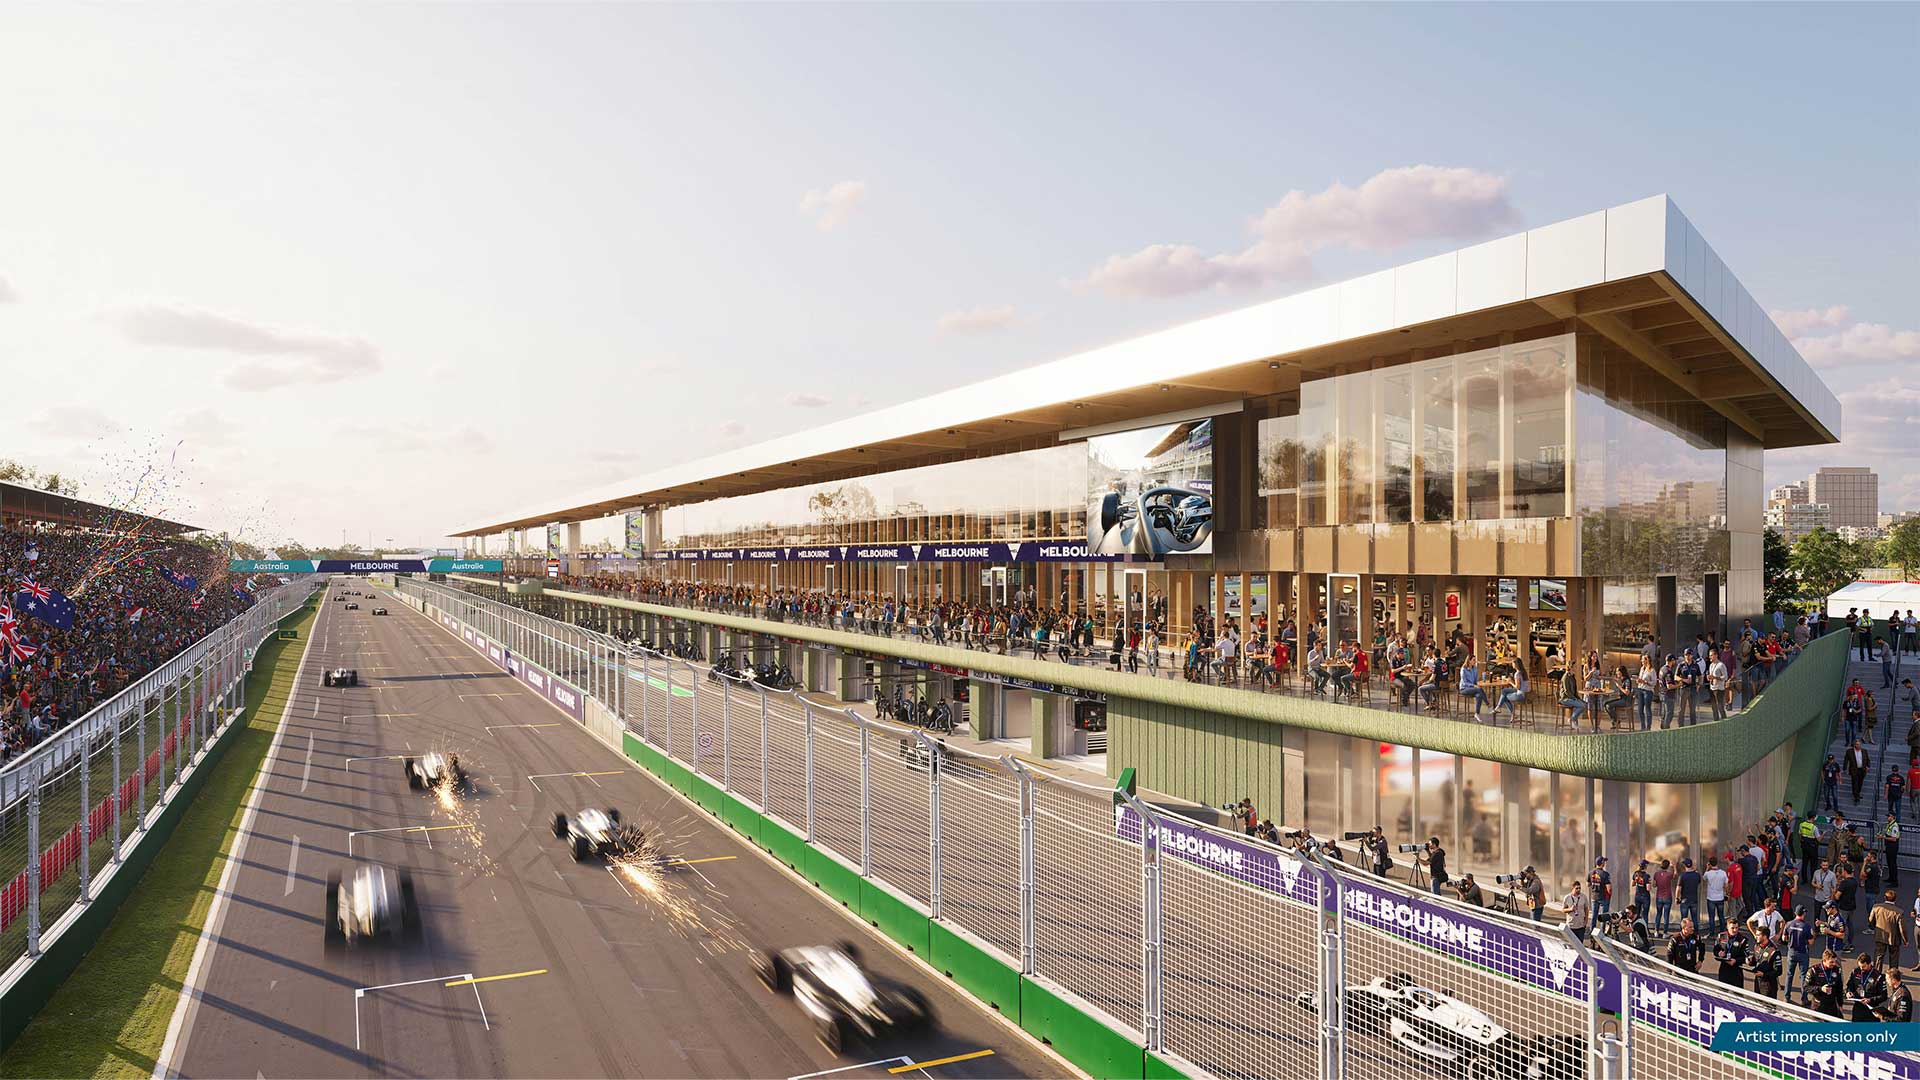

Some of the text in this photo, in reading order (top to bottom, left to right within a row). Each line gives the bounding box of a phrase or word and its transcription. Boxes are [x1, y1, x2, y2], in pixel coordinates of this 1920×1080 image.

[750, 551, 777, 559] MELBOURNE
[798, 551, 830, 559] MELBOURNE
[857, 549, 899, 558] MELBOURNE
[935, 548, 990, 558] MELBOURNE
[350, 562, 399, 571] MELBOURNE
[451, 562, 484, 571] Australia
